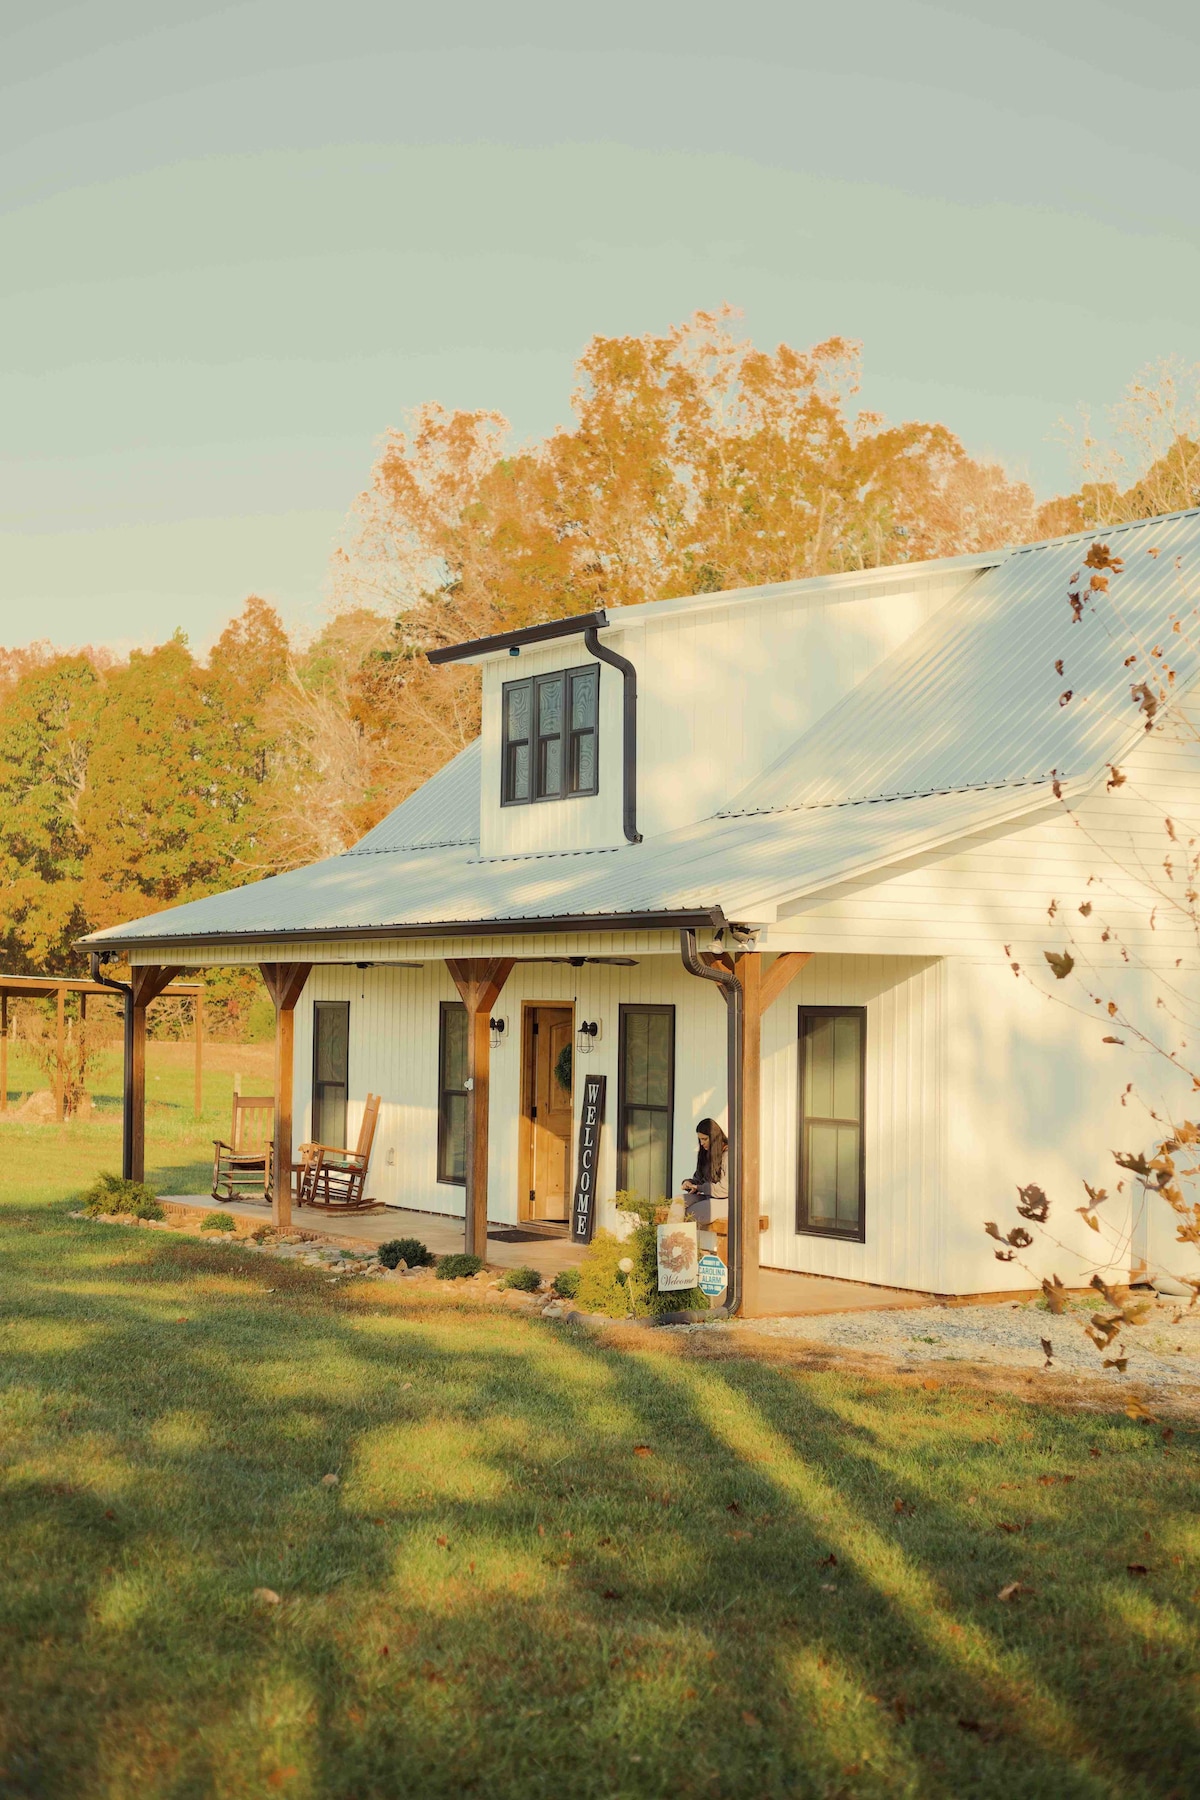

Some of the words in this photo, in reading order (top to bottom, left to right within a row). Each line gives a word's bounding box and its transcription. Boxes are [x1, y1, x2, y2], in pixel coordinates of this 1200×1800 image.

[576, 1084, 599, 1235] WELCOME
[698, 1266, 725, 1276] CAROLINA
[660, 1273, 694, 1286] Welcome
[702, 1275, 722, 1283] ALARM
